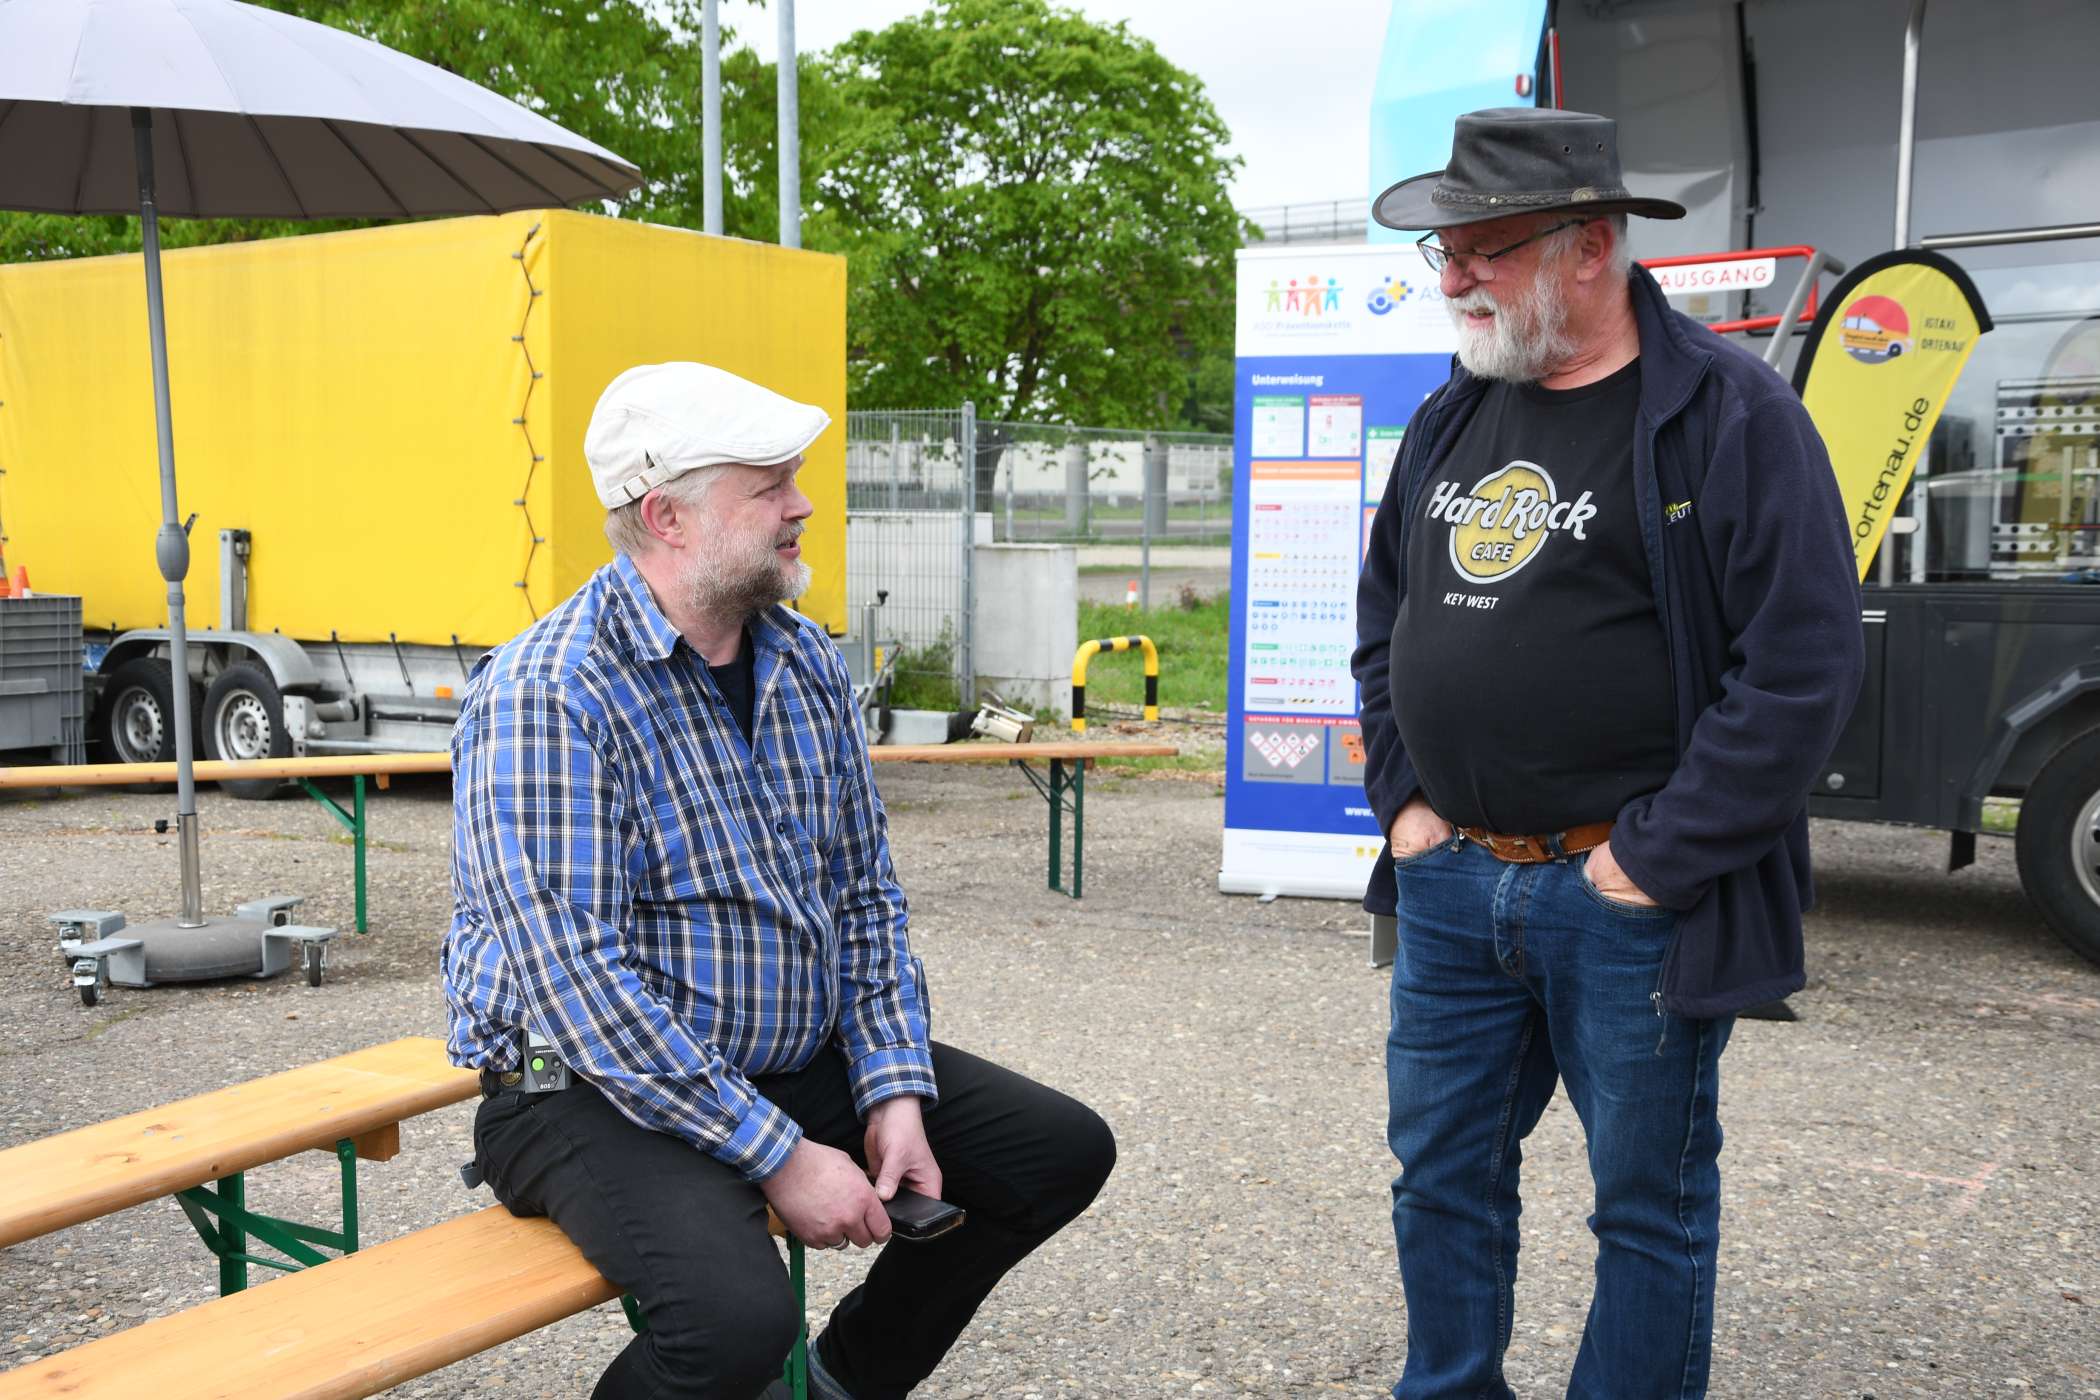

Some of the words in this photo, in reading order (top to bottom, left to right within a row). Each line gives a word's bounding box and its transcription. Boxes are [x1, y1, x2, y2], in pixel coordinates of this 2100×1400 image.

[1660, 266, 1767, 288] AUSGANG
[1251, 373, 1324, 387] Unterweisung
[1425, 481, 1512, 529] Hard
[1501, 487, 1597, 540] Rock
[1471, 542, 1515, 562] CAFE
[1443, 592, 1466, 606] KEY
[1466, 595, 1499, 610] WEST
